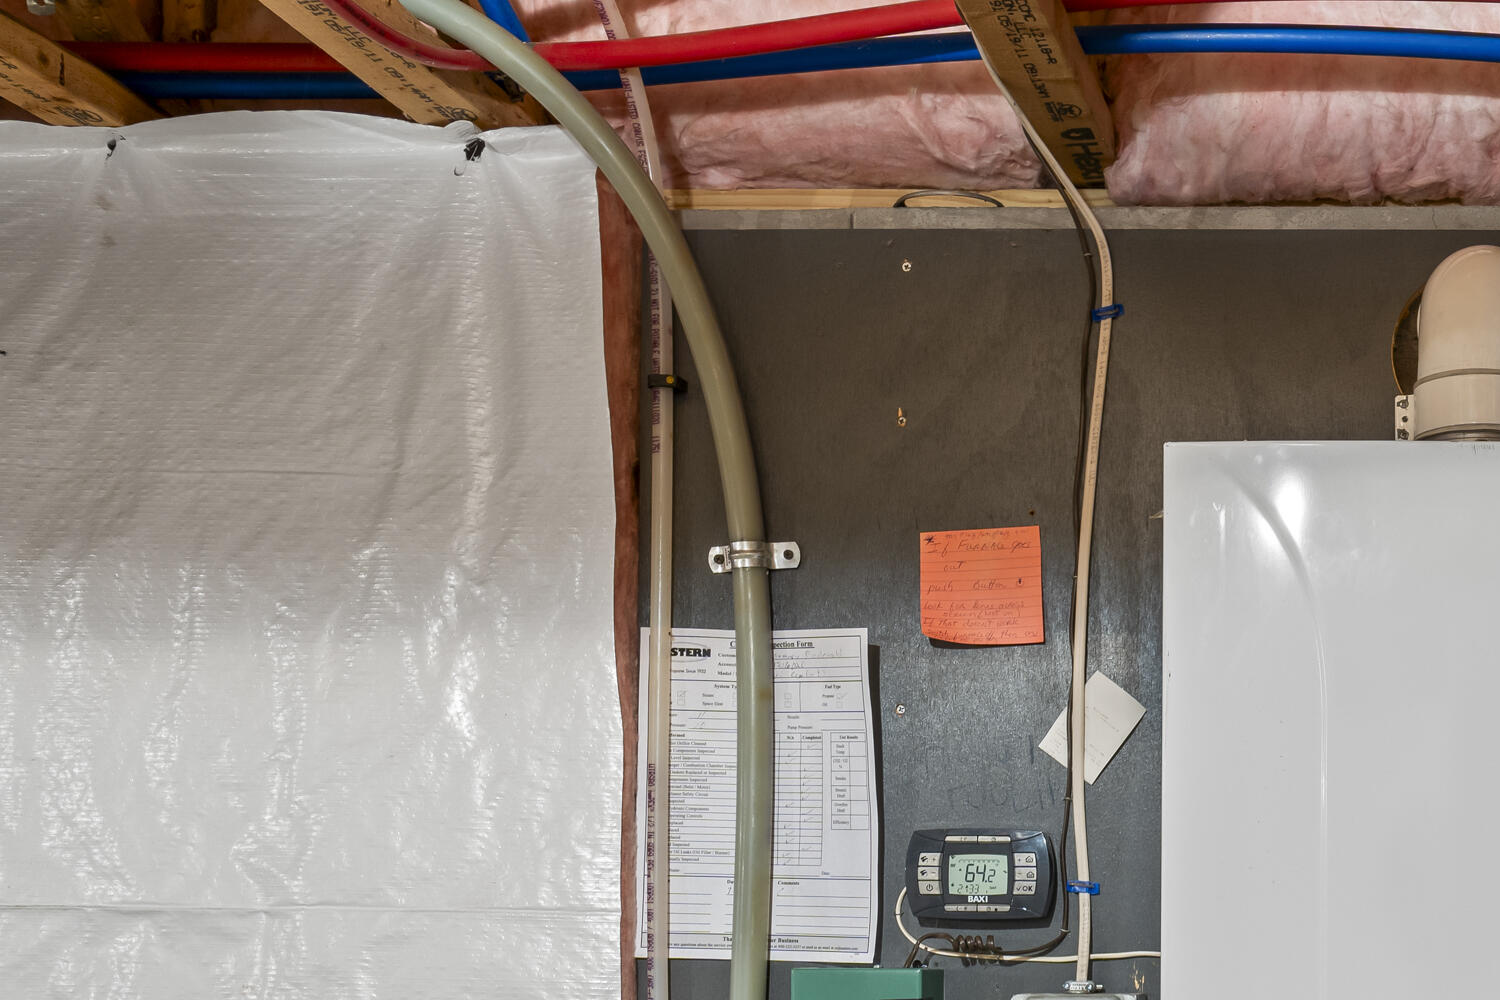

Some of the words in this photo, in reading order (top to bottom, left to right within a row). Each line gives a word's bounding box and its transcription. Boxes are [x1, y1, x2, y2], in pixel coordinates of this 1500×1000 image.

[670, 647, 711, 658] STERN
[965, 864, 996, 883] 64.2
[967, 895, 988, 903] BAXI
